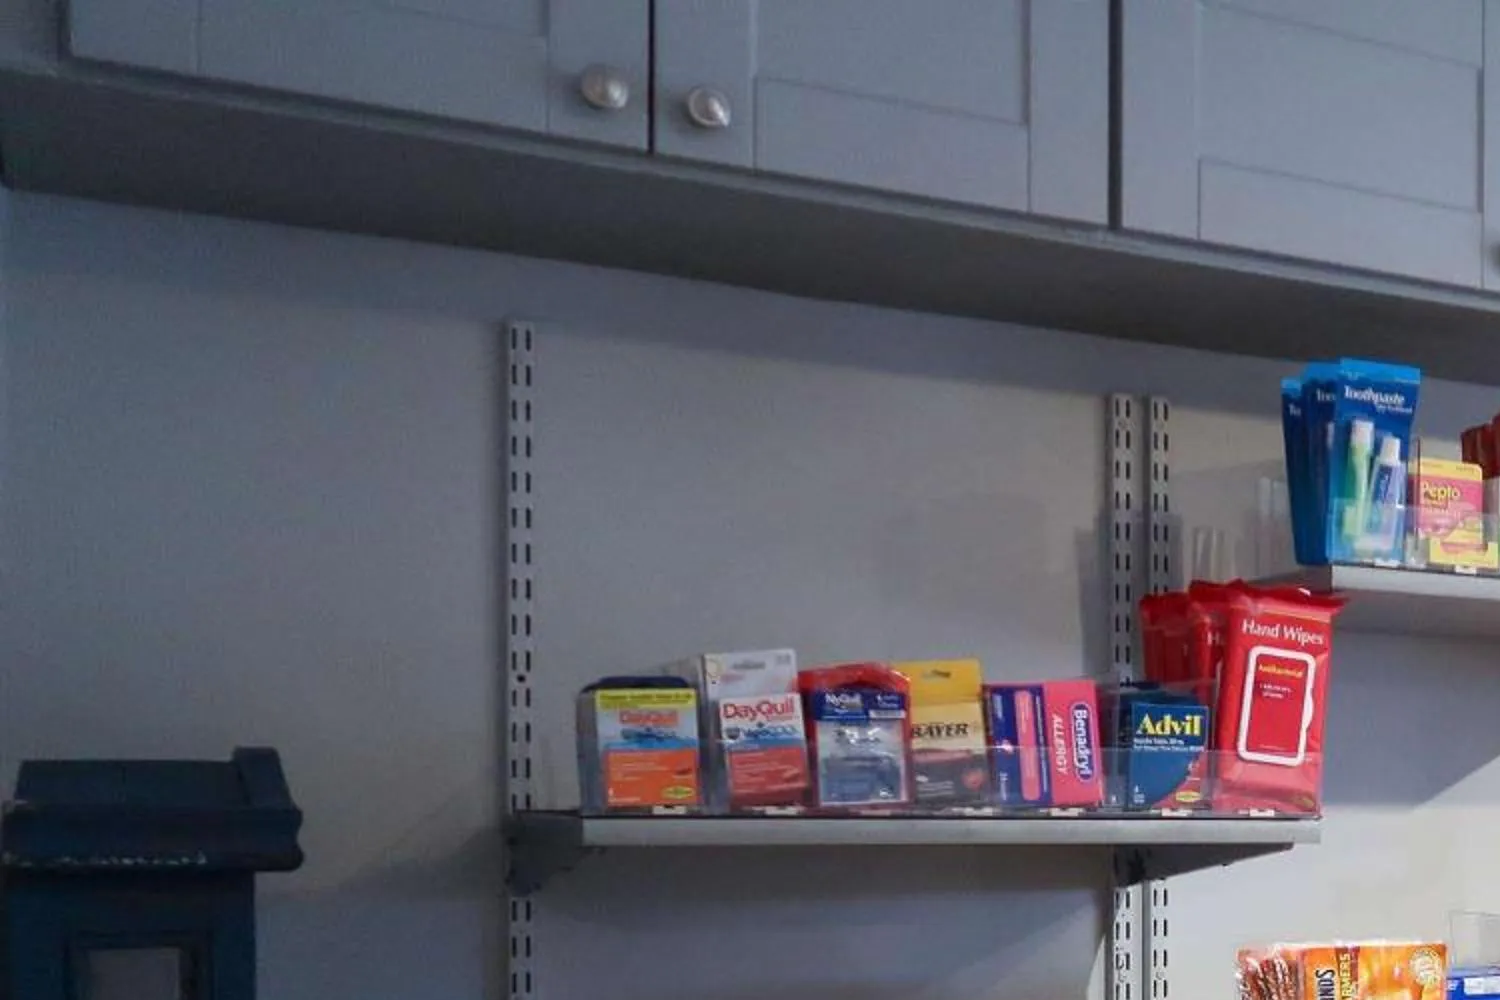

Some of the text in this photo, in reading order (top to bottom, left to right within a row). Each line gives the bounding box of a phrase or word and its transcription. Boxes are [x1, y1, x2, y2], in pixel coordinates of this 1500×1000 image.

[1242, 618, 1281, 639] Hand
[1283, 624, 1324, 646] Wipes
[723, 696, 794, 721] DayQuil
[1135, 712, 1203, 736] Advil
[1073, 708, 1092, 777] Benadryl
